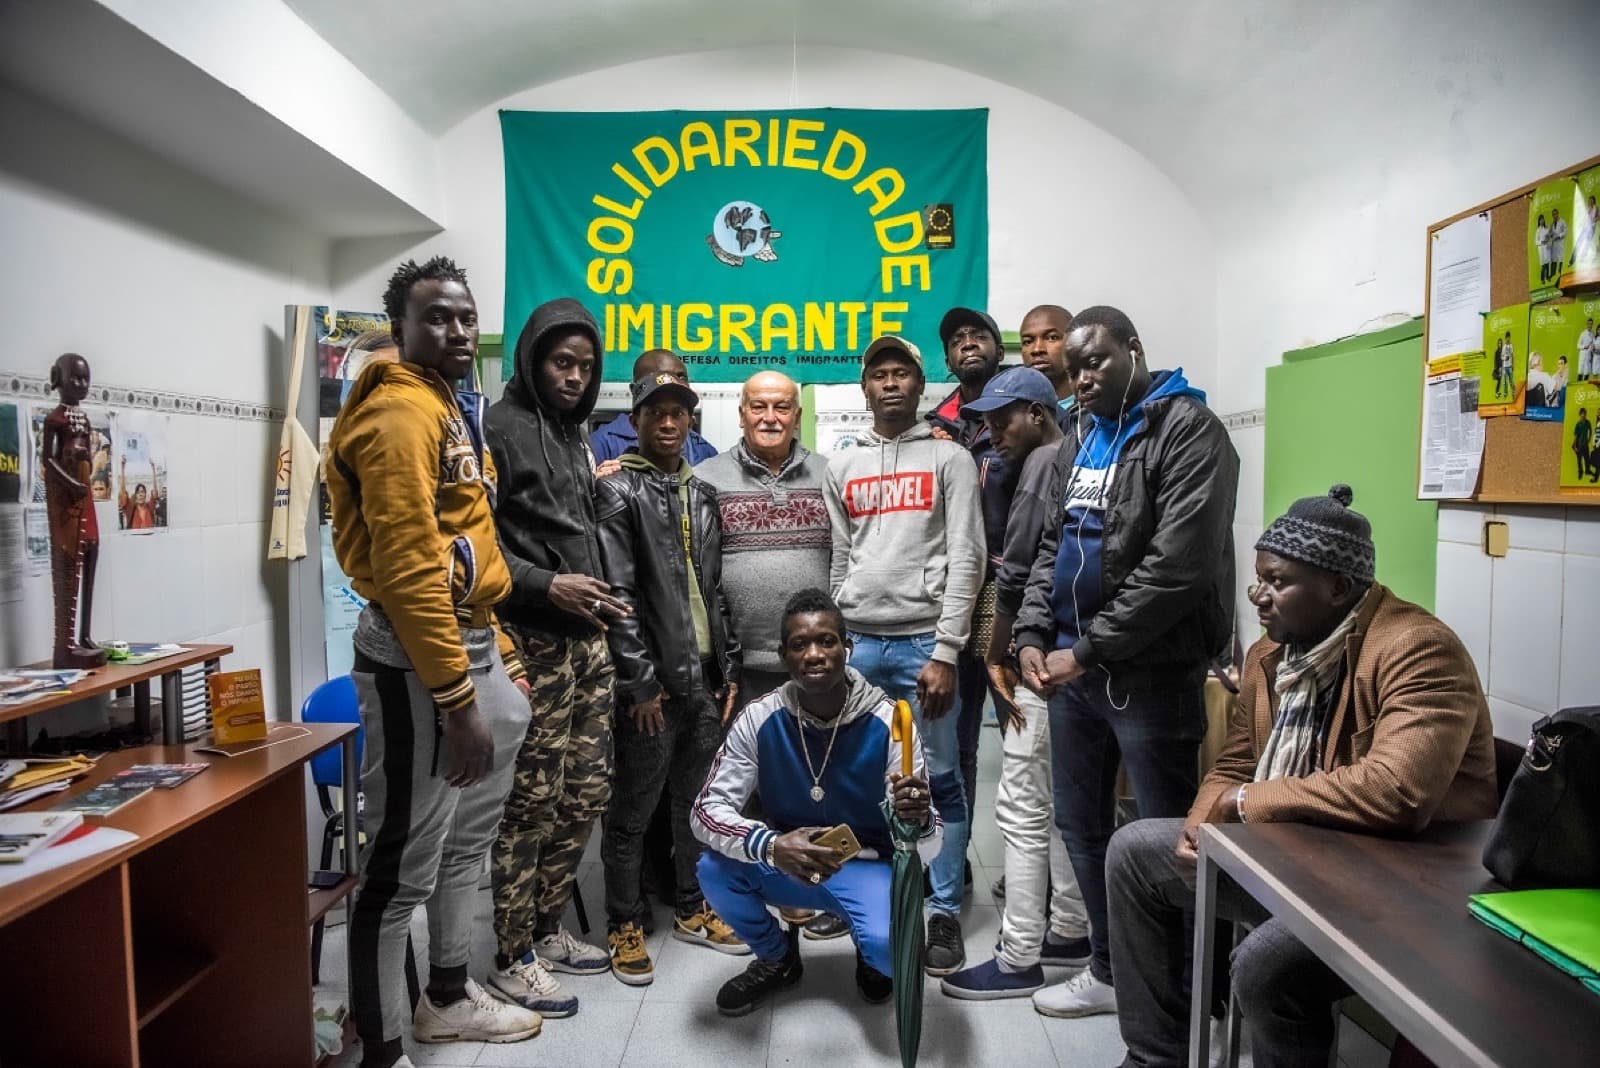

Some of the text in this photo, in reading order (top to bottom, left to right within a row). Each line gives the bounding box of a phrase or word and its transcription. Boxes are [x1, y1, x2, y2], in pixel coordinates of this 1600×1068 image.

[587, 118, 931, 295] SOLIDARIEDADE
[604, 302, 908, 353] IMIGRANTE
[729, 355, 787, 366] DIREITOS
[851, 476, 925, 513] MARVEL
